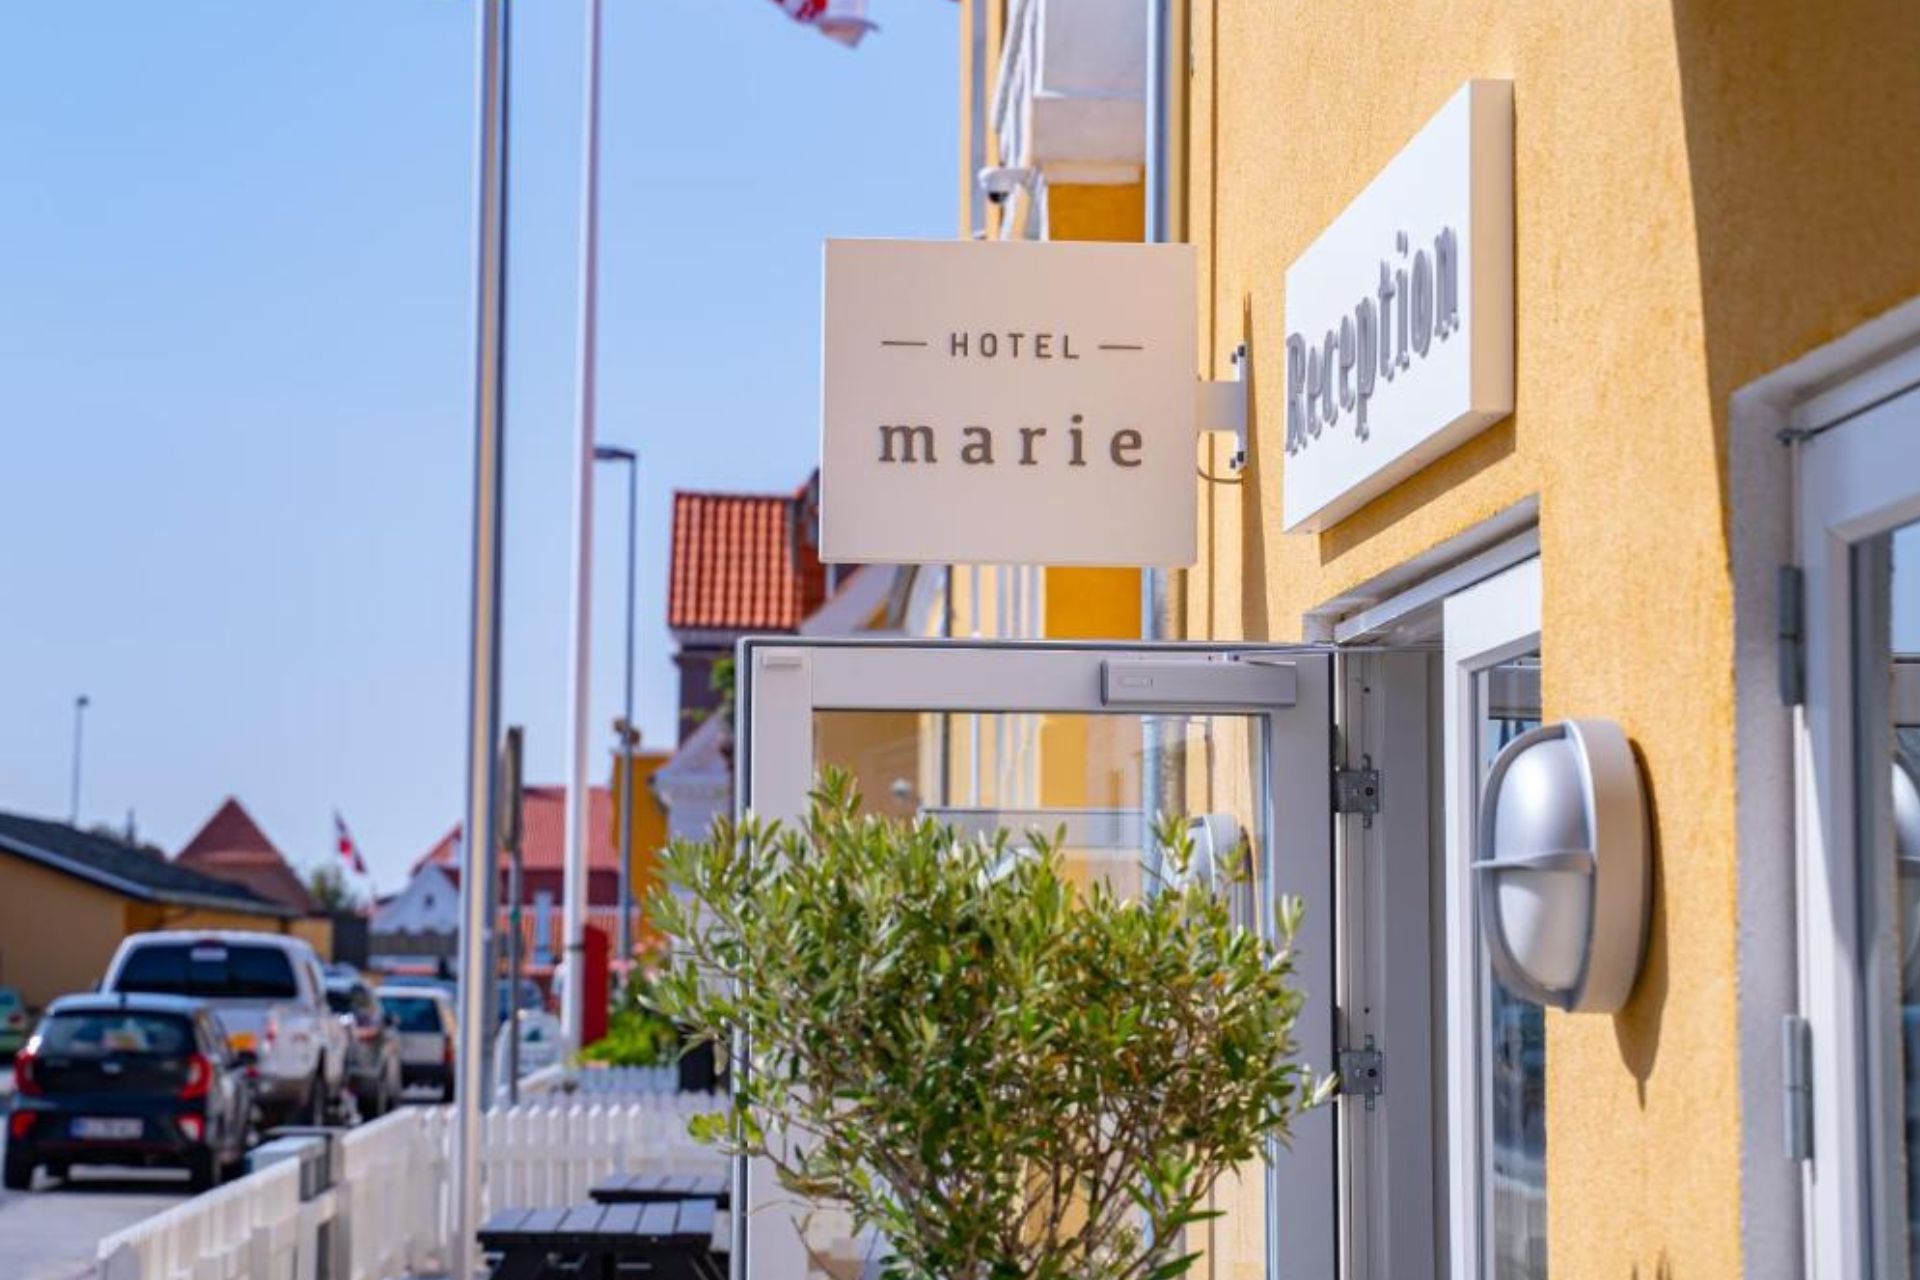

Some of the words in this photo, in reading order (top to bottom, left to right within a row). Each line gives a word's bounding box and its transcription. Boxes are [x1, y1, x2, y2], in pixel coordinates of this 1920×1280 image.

[950, 332, 1080, 359] HOTEL
[1286, 226, 1459, 456] Reception
[878, 414, 1143, 467] marie
